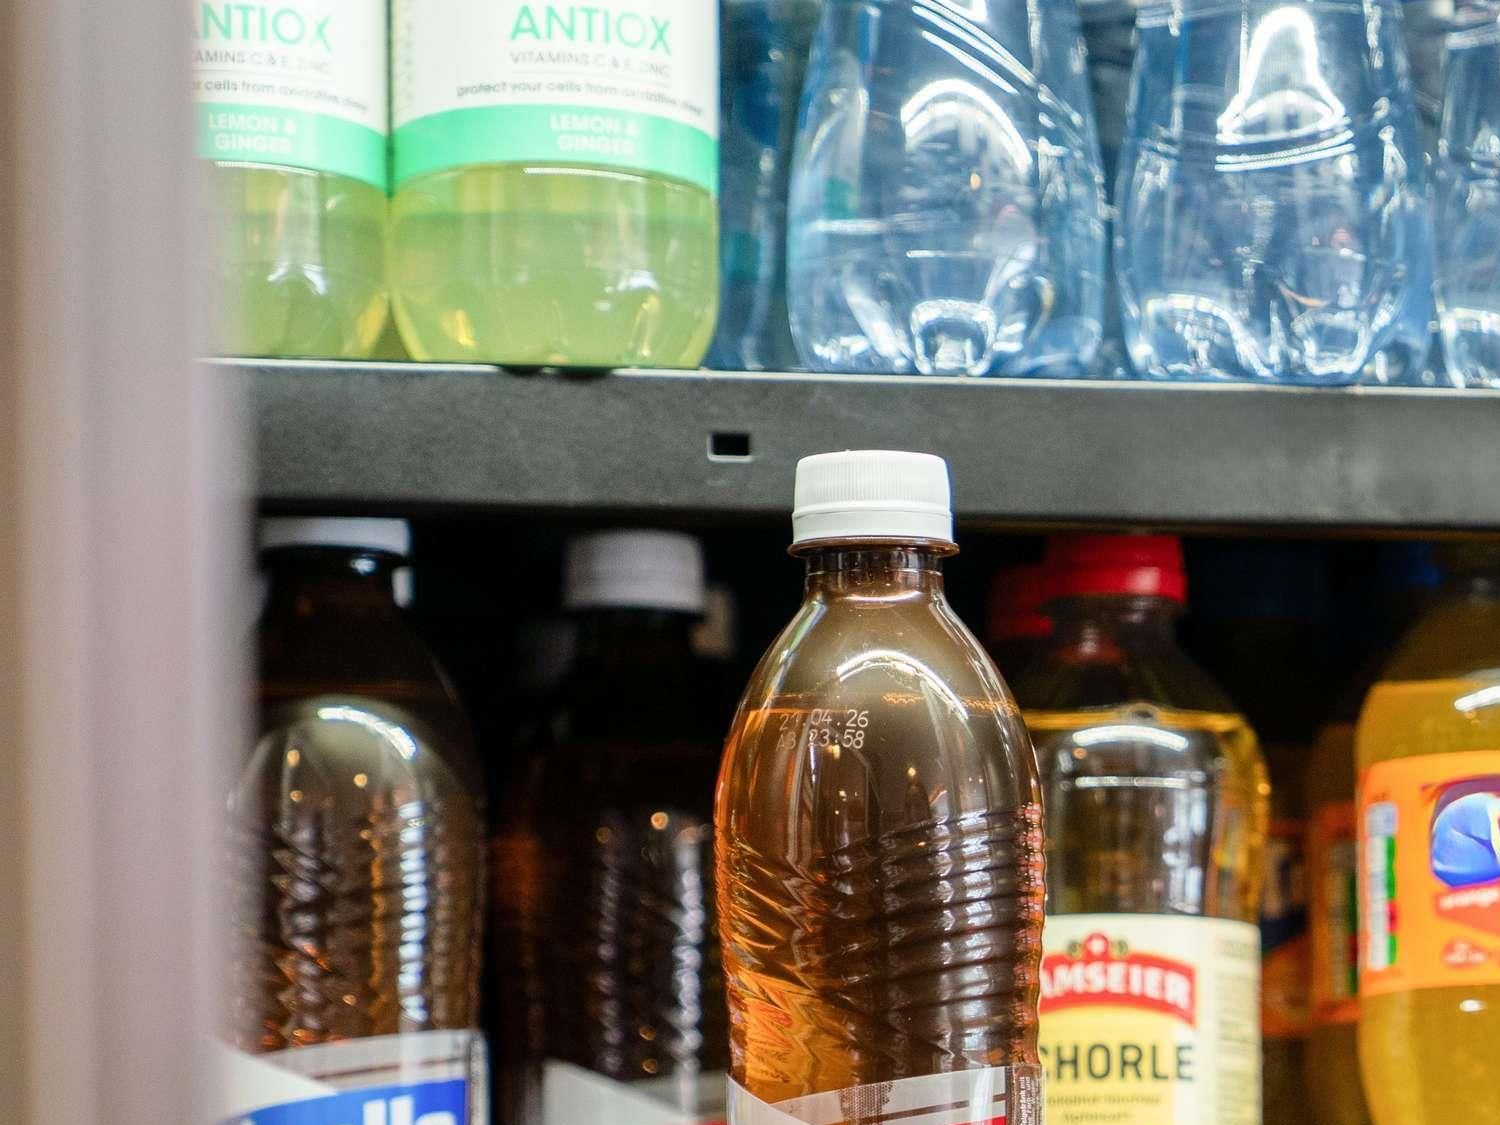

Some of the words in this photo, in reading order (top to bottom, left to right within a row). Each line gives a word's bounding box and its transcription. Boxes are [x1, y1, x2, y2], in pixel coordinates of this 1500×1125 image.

[193, 4, 332, 52] NTIOX
[510, 4, 672, 55] ANTIOX
[207, 111, 276, 132] LEMON
[551, 112, 619, 134] LEMON
[214, 132, 293, 153] GINGER
[557, 135, 637, 156] GINGER
